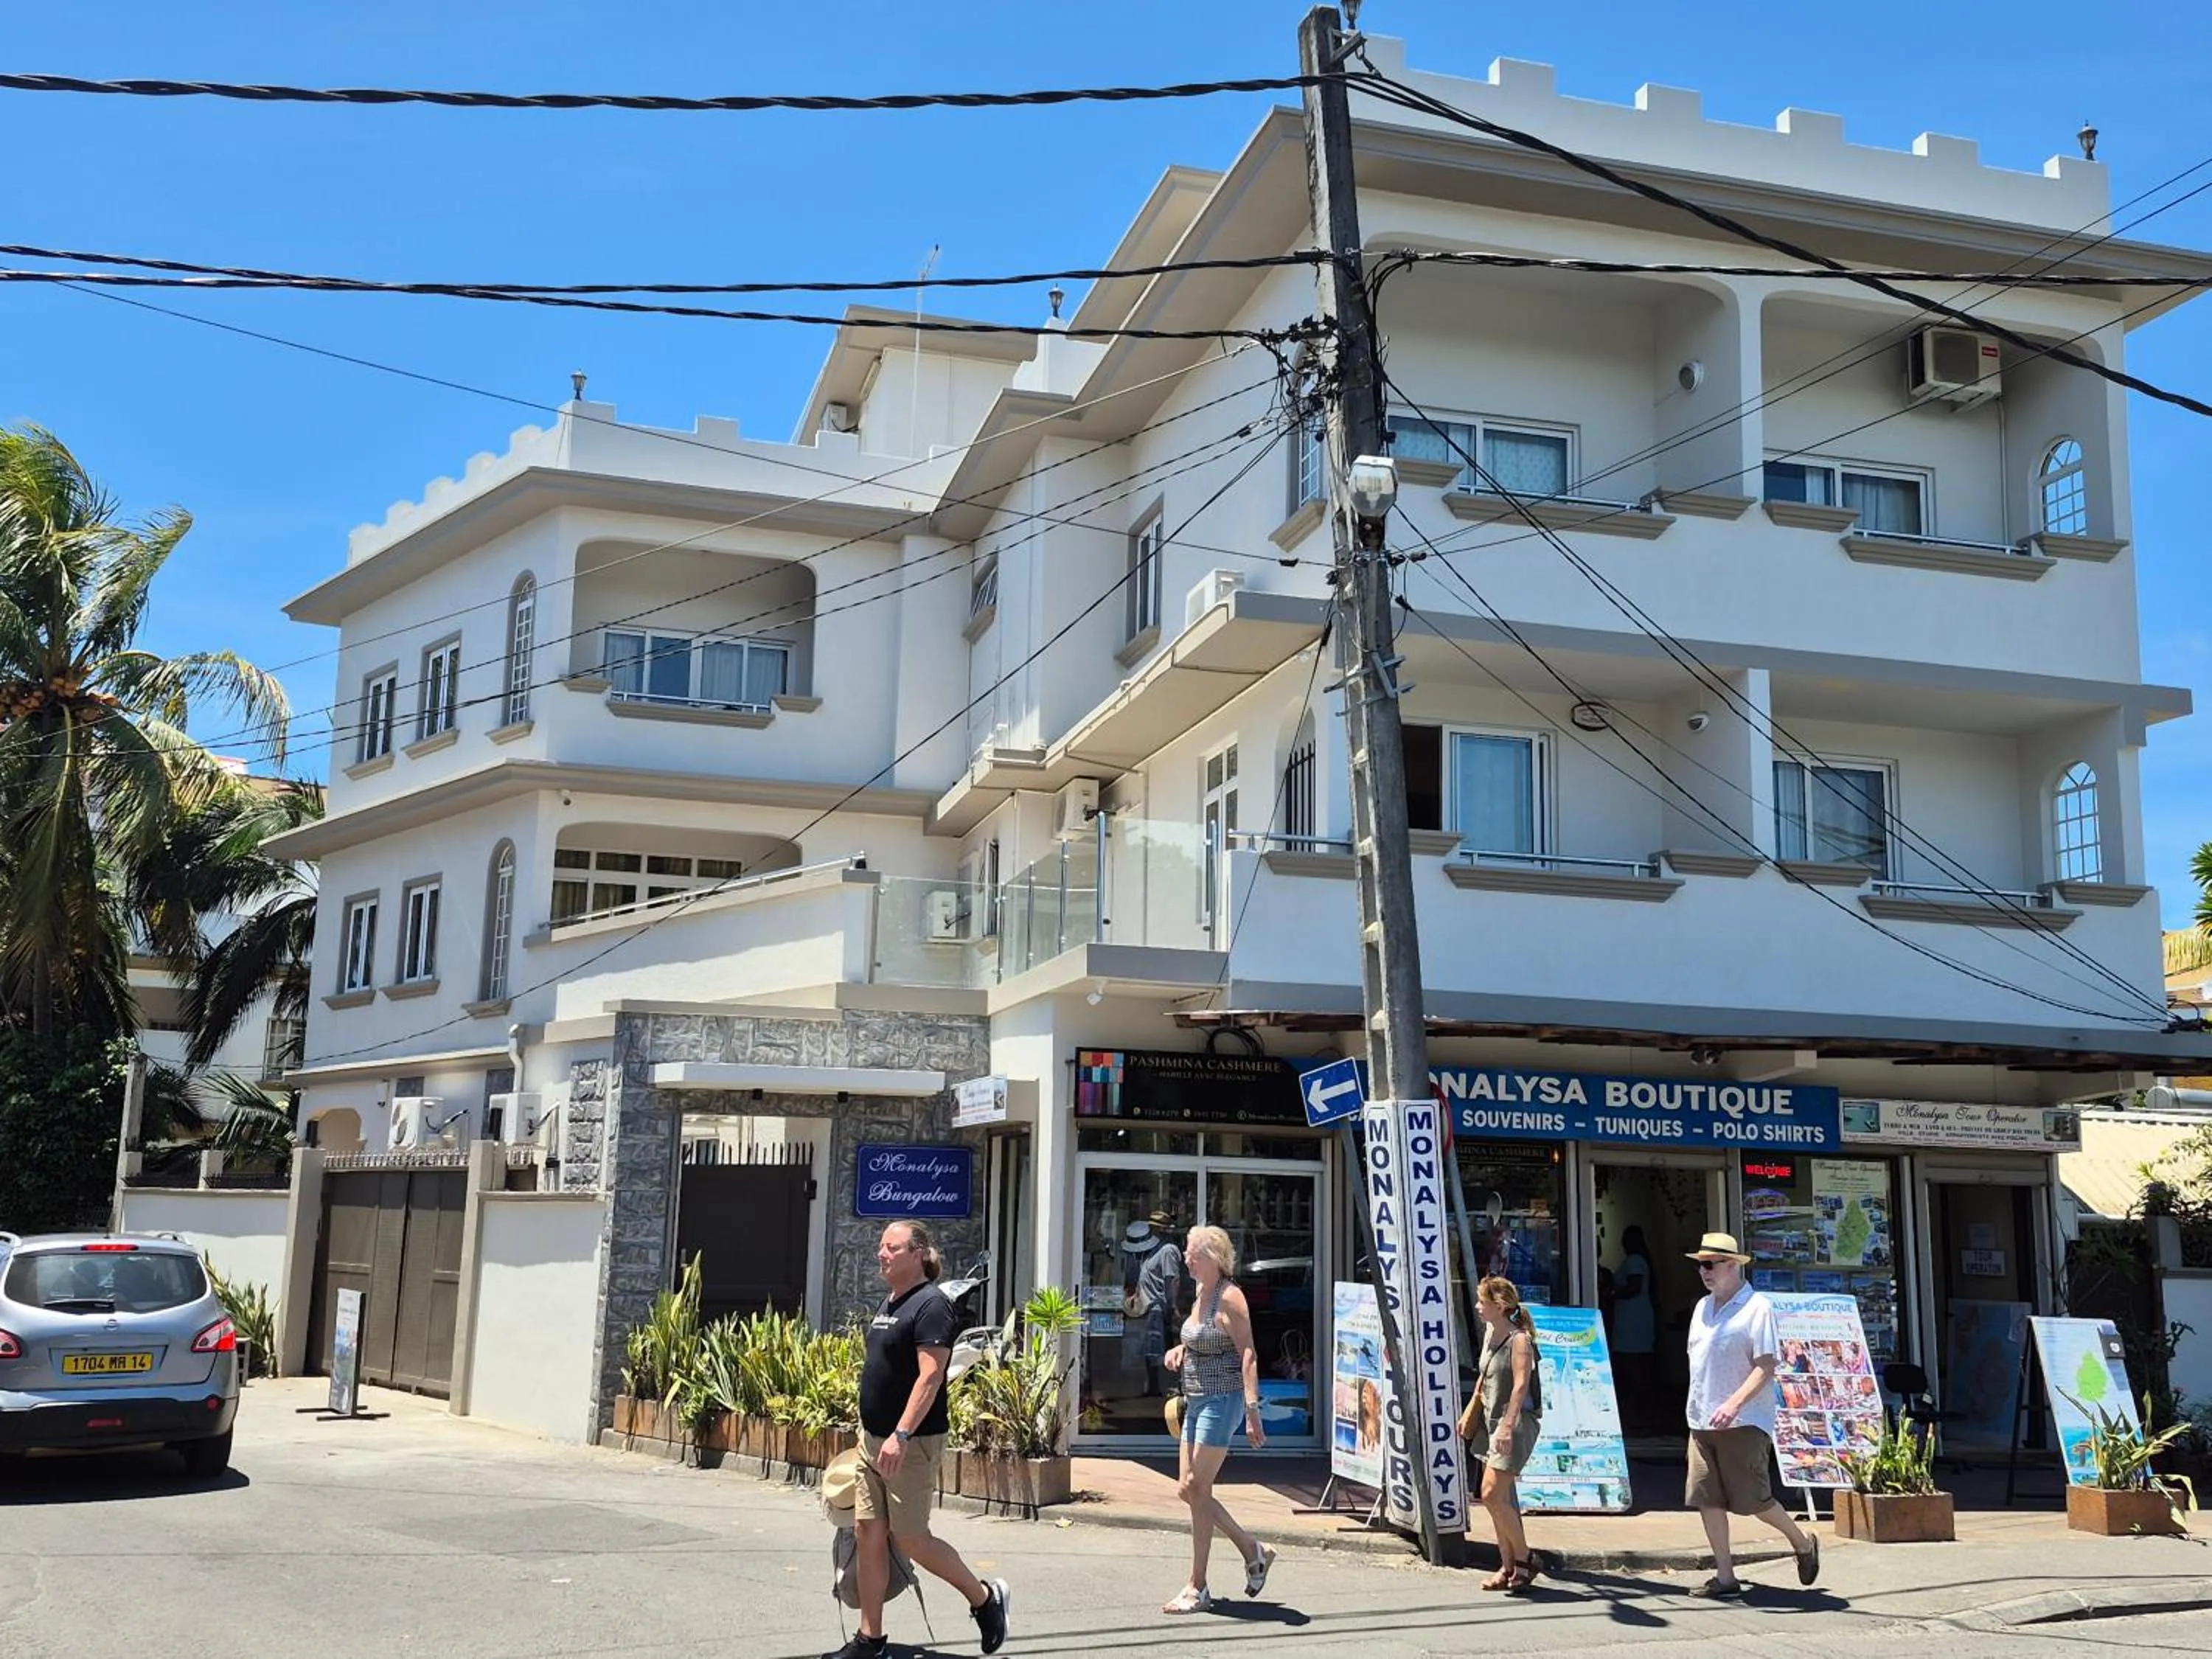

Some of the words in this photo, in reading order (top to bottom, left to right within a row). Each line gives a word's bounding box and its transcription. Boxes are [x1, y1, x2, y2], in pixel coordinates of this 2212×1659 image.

[1130, 1054, 1202, 1070] PASHMINA
[1206, 1059, 1281, 1074] CASHMERE
[1429, 1071, 1587, 1105] NALYSA
[1604, 1080, 1794, 1119] BOUTIQUE
[1462, 1109, 1565, 1132] SOUVENIRS
[1594, 1116, 1683, 1140] TUNIQUES
[1712, 1121, 1759, 1141] POLO
[1763, 1124, 1826, 1144] SHIRTS
[1955, 1106, 1981, 1121] Tour
[869, 1152, 959, 1180] Monalysa
[1745, 1164, 1792, 1177] WELCOME
[868, 1180, 958, 1209] Bungalow
[1408, 1111, 1443, 1304] MONALYSA
[1368, 1119, 1401, 1338] MONALYS
[1773, 1301, 1804, 1311] ALYSA
[72, 1357, 105, 1371] 1704
[132, 1355, 146, 1369] 14
[1423, 1320, 1456, 1520] HOLIDAYS
